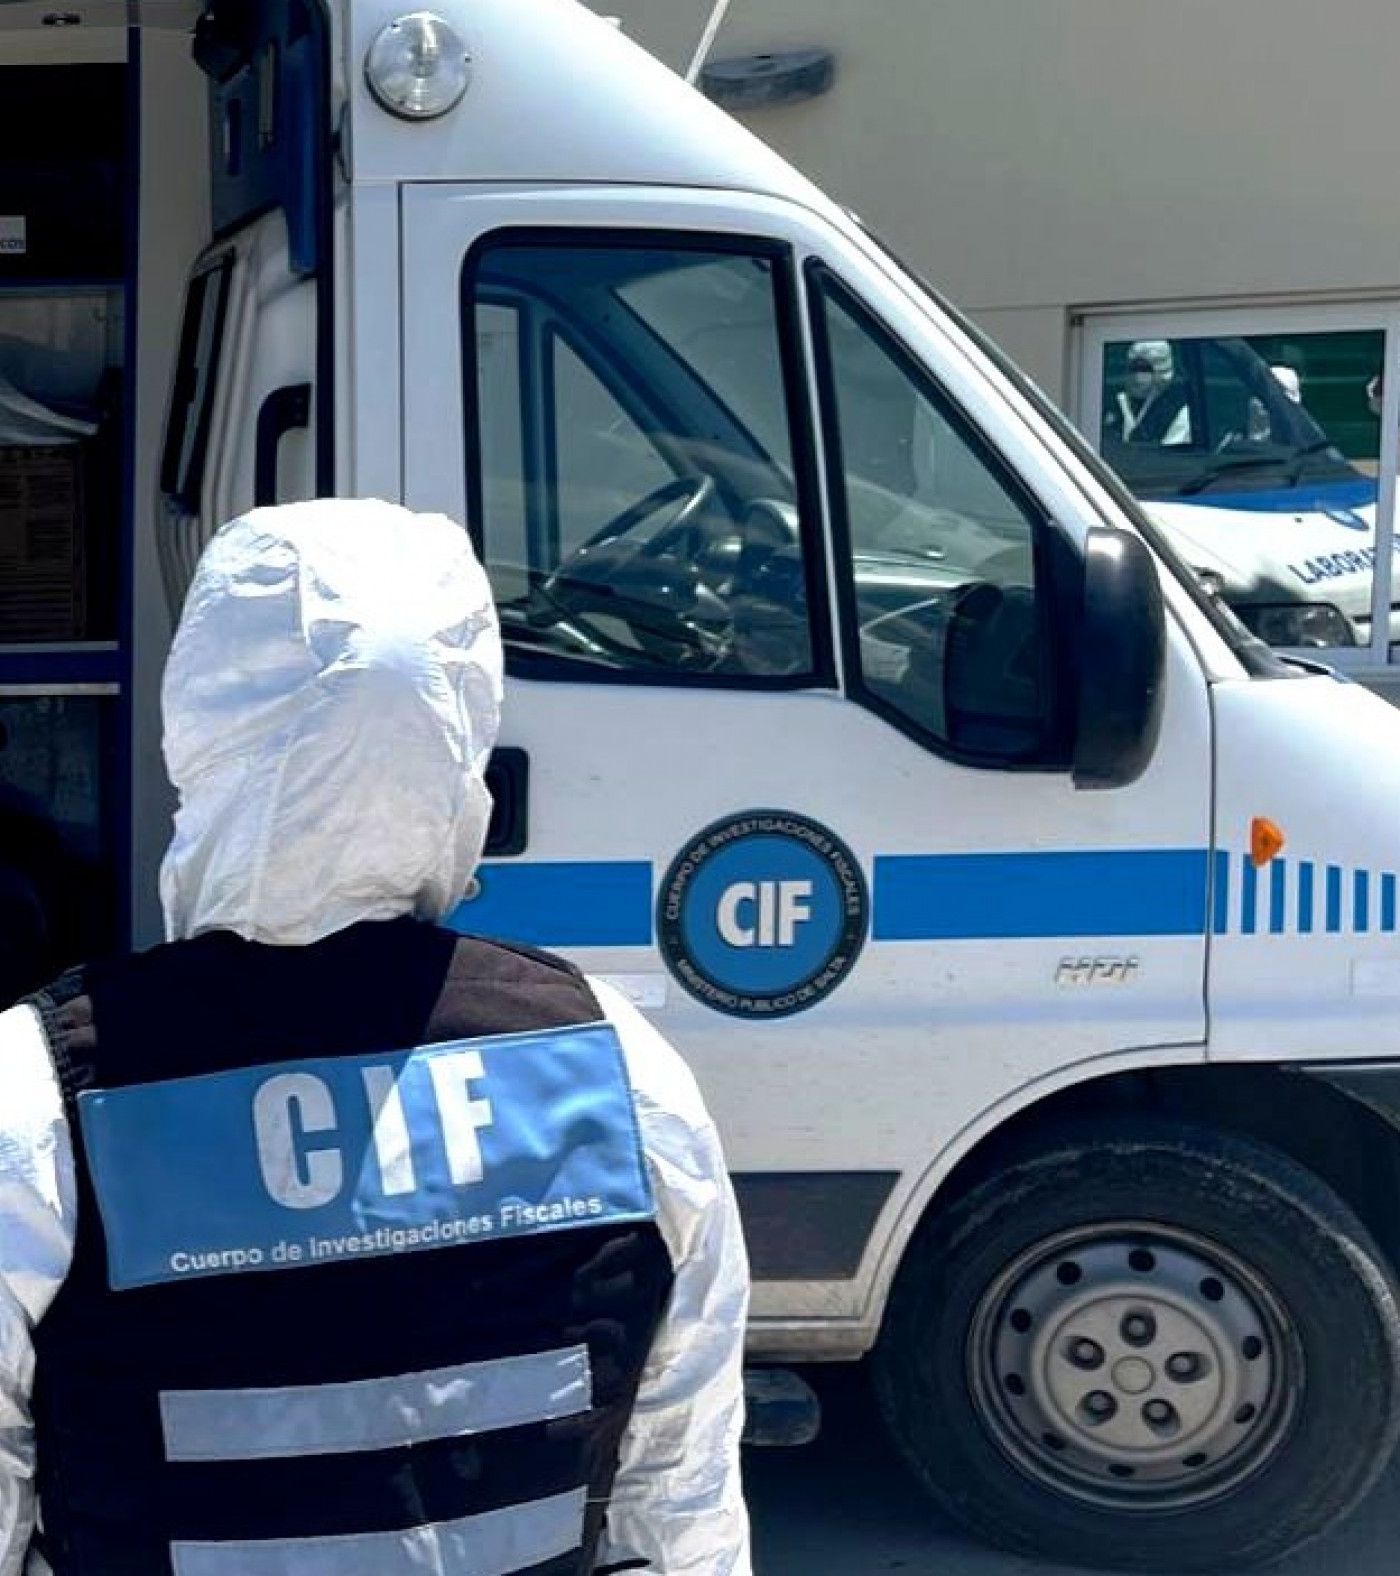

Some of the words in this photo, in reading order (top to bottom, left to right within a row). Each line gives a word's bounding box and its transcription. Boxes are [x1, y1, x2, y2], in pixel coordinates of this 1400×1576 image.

[666, 862, 695, 920] CUERPO
[689, 843, 710, 863] DE
[706, 819, 832, 853] INVESTIGACIONES
[830, 850, 860, 916] FISCALES
[717, 880, 813, 947] CIF
[676, 958, 738, 1008] MINISTERIO
[796, 983, 816, 1001] DE
[813, 956, 847, 989] SALTA
[252, 1051, 494, 1210] CIF
[170, 1246, 263, 1274] Cuerpo
[271, 1239, 302, 1263] de
[309, 1213, 494, 1258] Investigaciones
[500, 1194, 602, 1228] Fiscales
